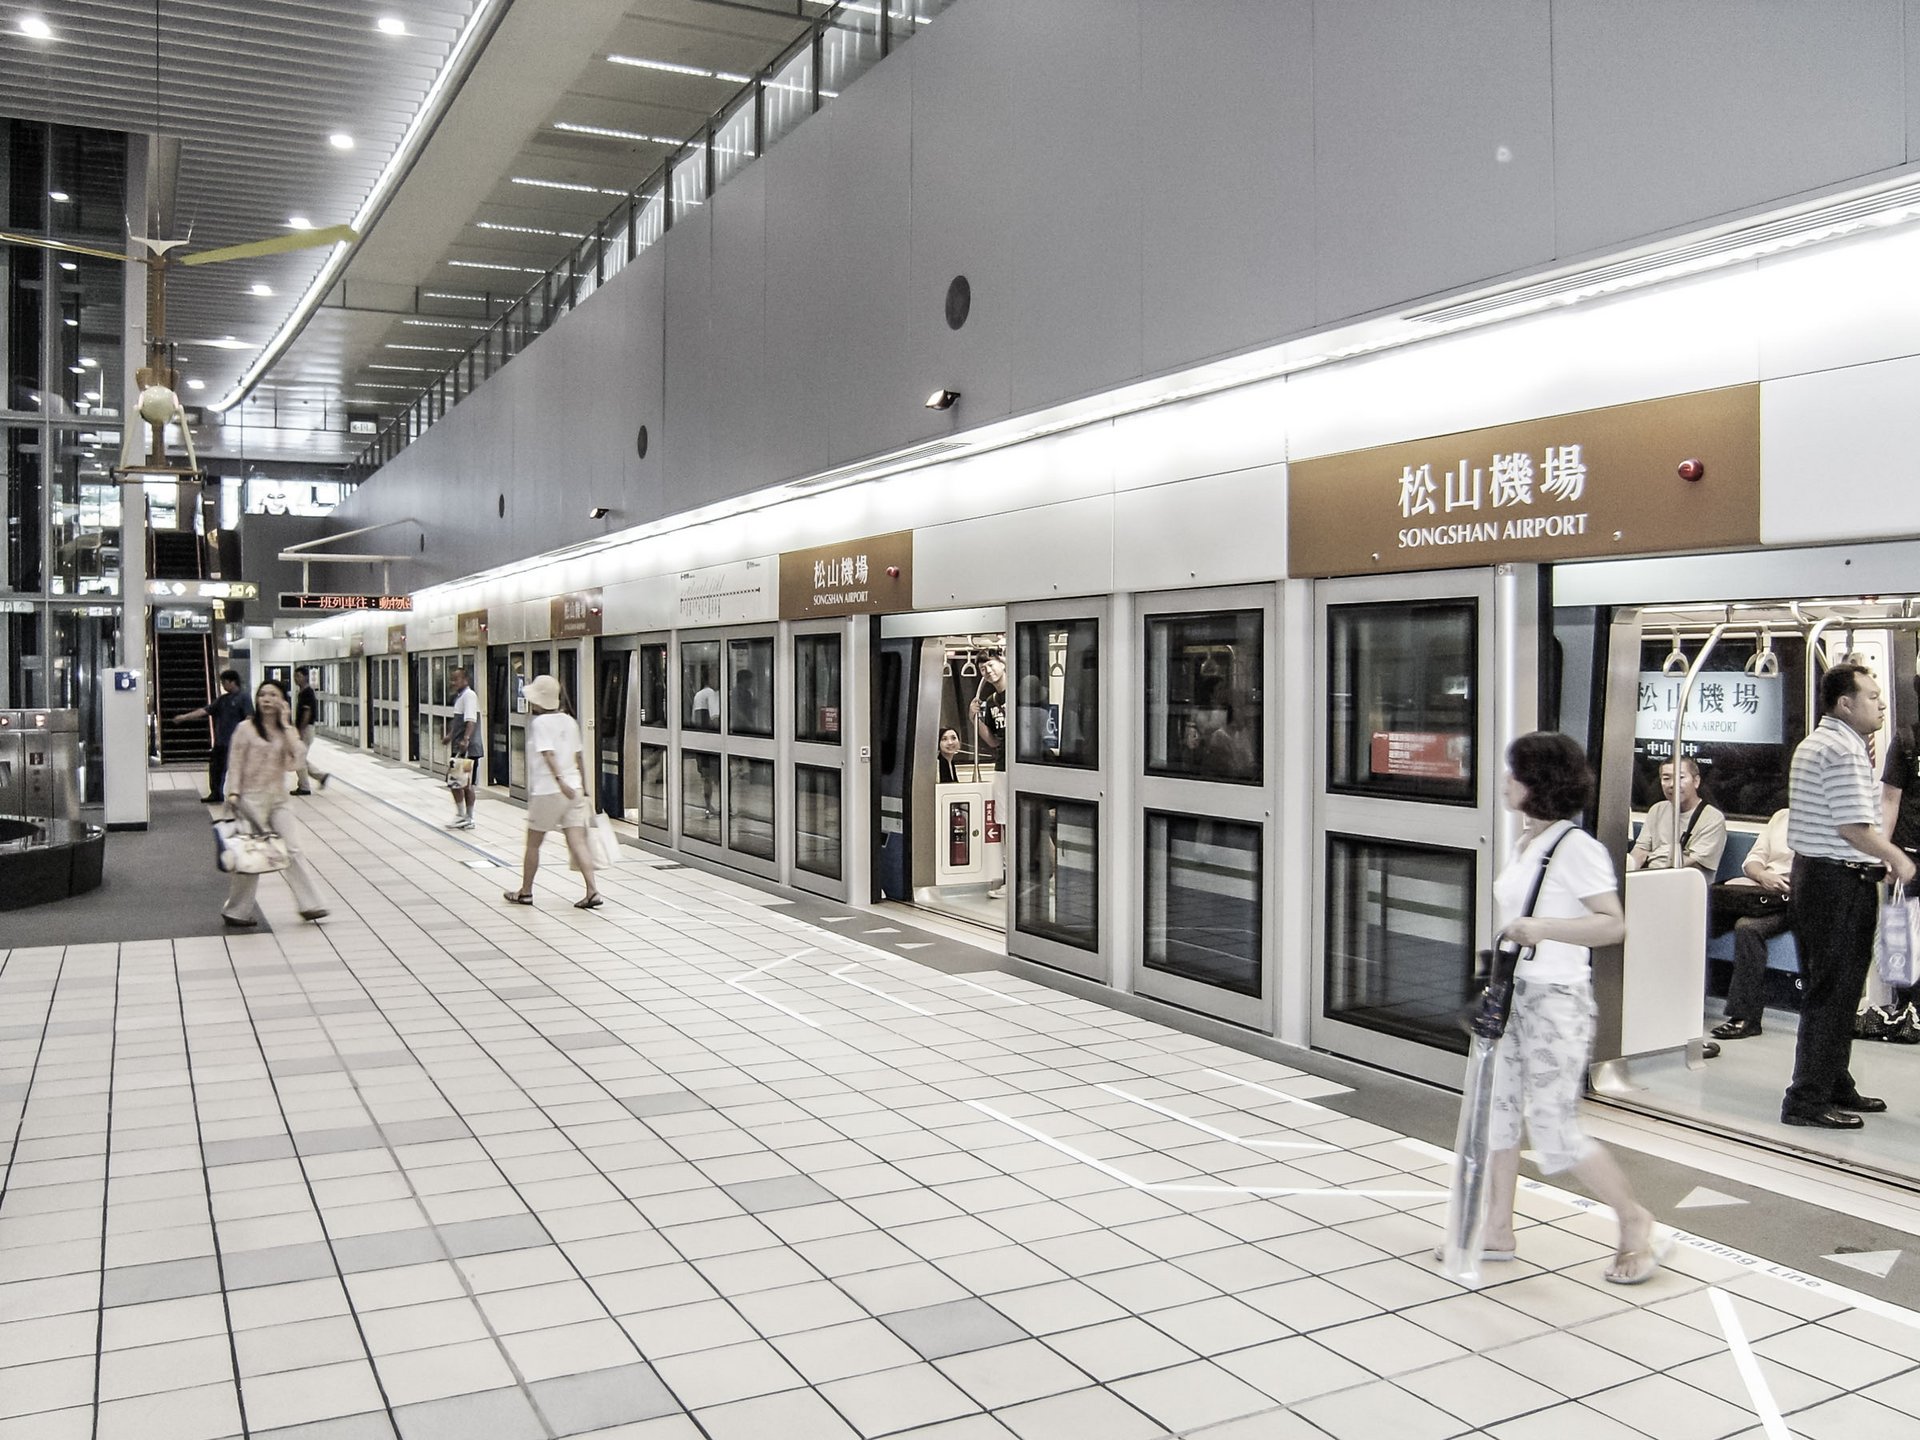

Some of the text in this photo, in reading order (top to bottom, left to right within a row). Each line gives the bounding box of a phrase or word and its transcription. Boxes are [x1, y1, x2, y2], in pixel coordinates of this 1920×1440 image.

[1397, 443, 1588, 519] 松山機場
[1397, 512, 1589, 549] SONGSHAN AIRPORT
[813, 554, 869, 590] 松山機場
[813, 590, 869, 606] SONGSHAN AIRPORT
[1701, 720, 1738, 733] AIRPORT
[1646, 741, 1698, 757] 中山中
[1671, 1231, 1822, 1288] Waiting Line
